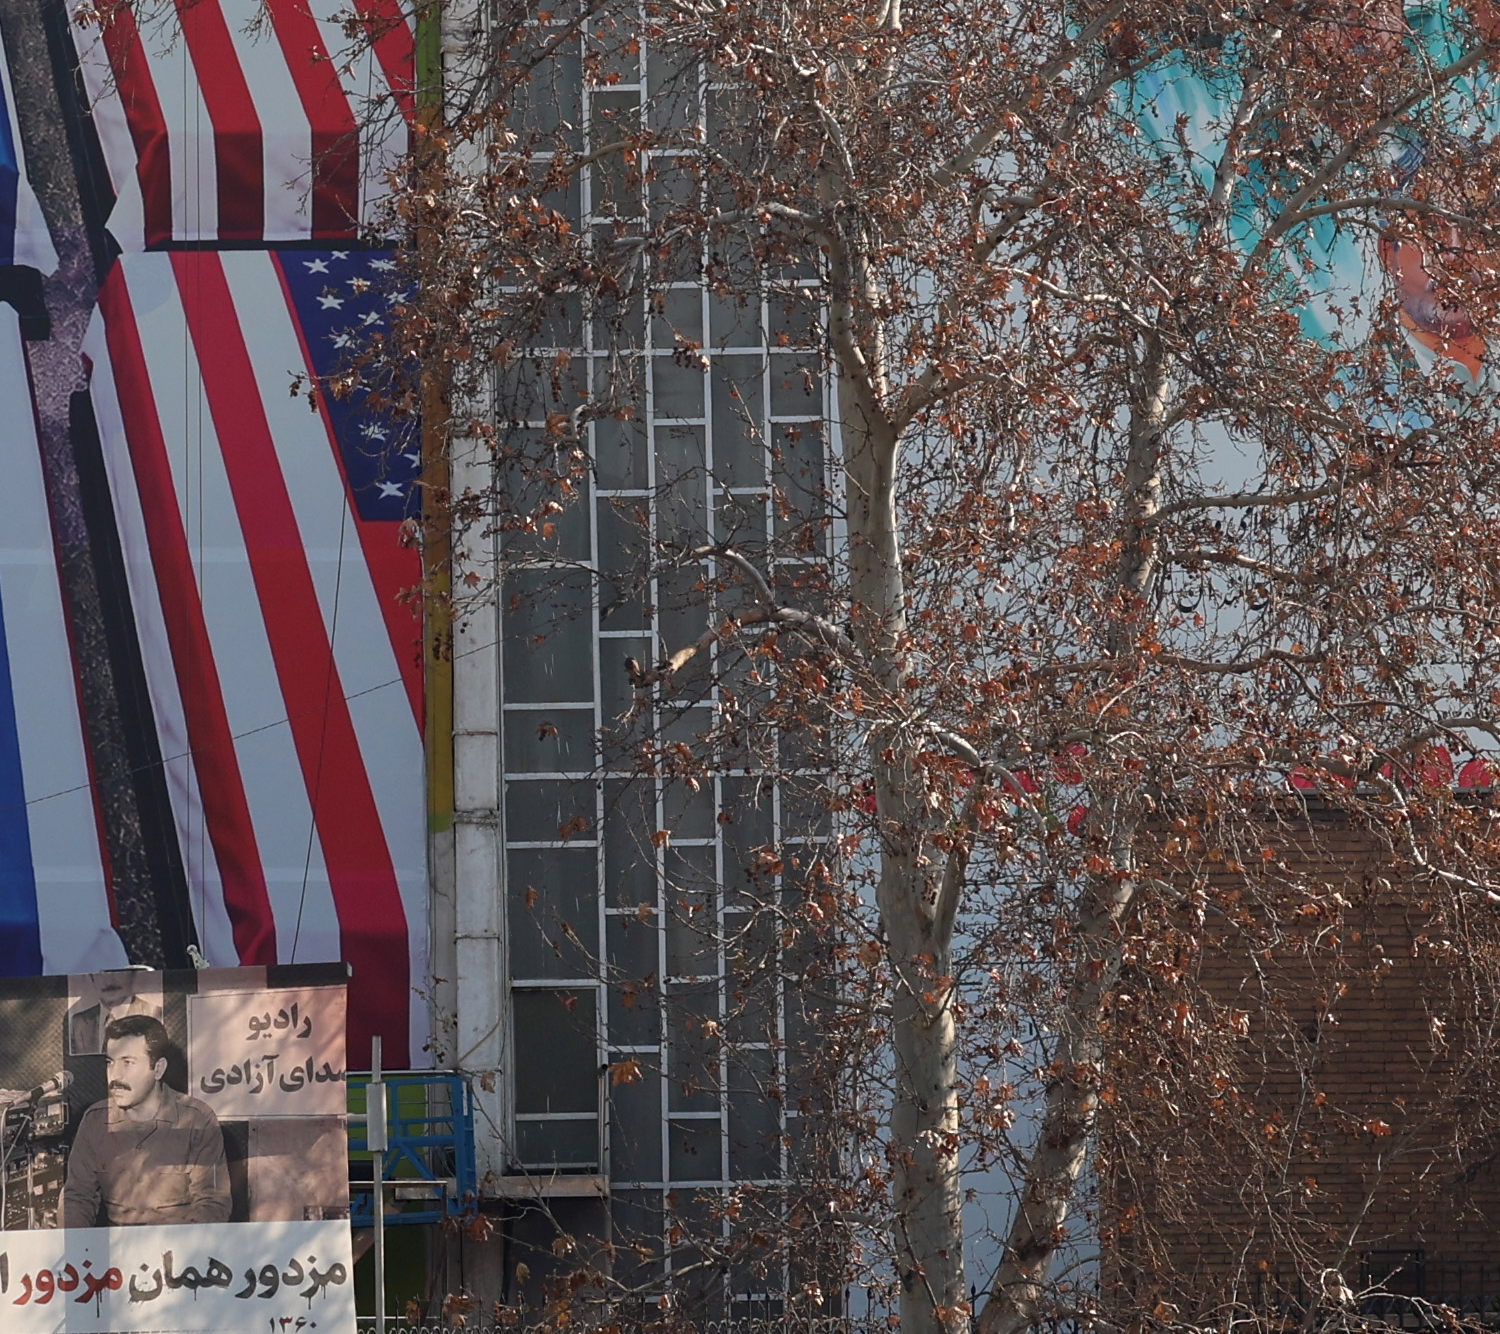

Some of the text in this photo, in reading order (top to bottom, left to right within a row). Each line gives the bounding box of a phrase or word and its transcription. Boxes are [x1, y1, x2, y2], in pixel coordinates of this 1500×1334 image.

[245, 1001, 313, 1041] رادیو
[200, 1053, 280, 1094] آزادی
[12, 1252, 124, 1307] مزدور
[127, 1249, 234, 1305] همان
[233, 1254, 347, 1307] مزدور
[268, 1315, 318, 1334] ۱۳۶۰
